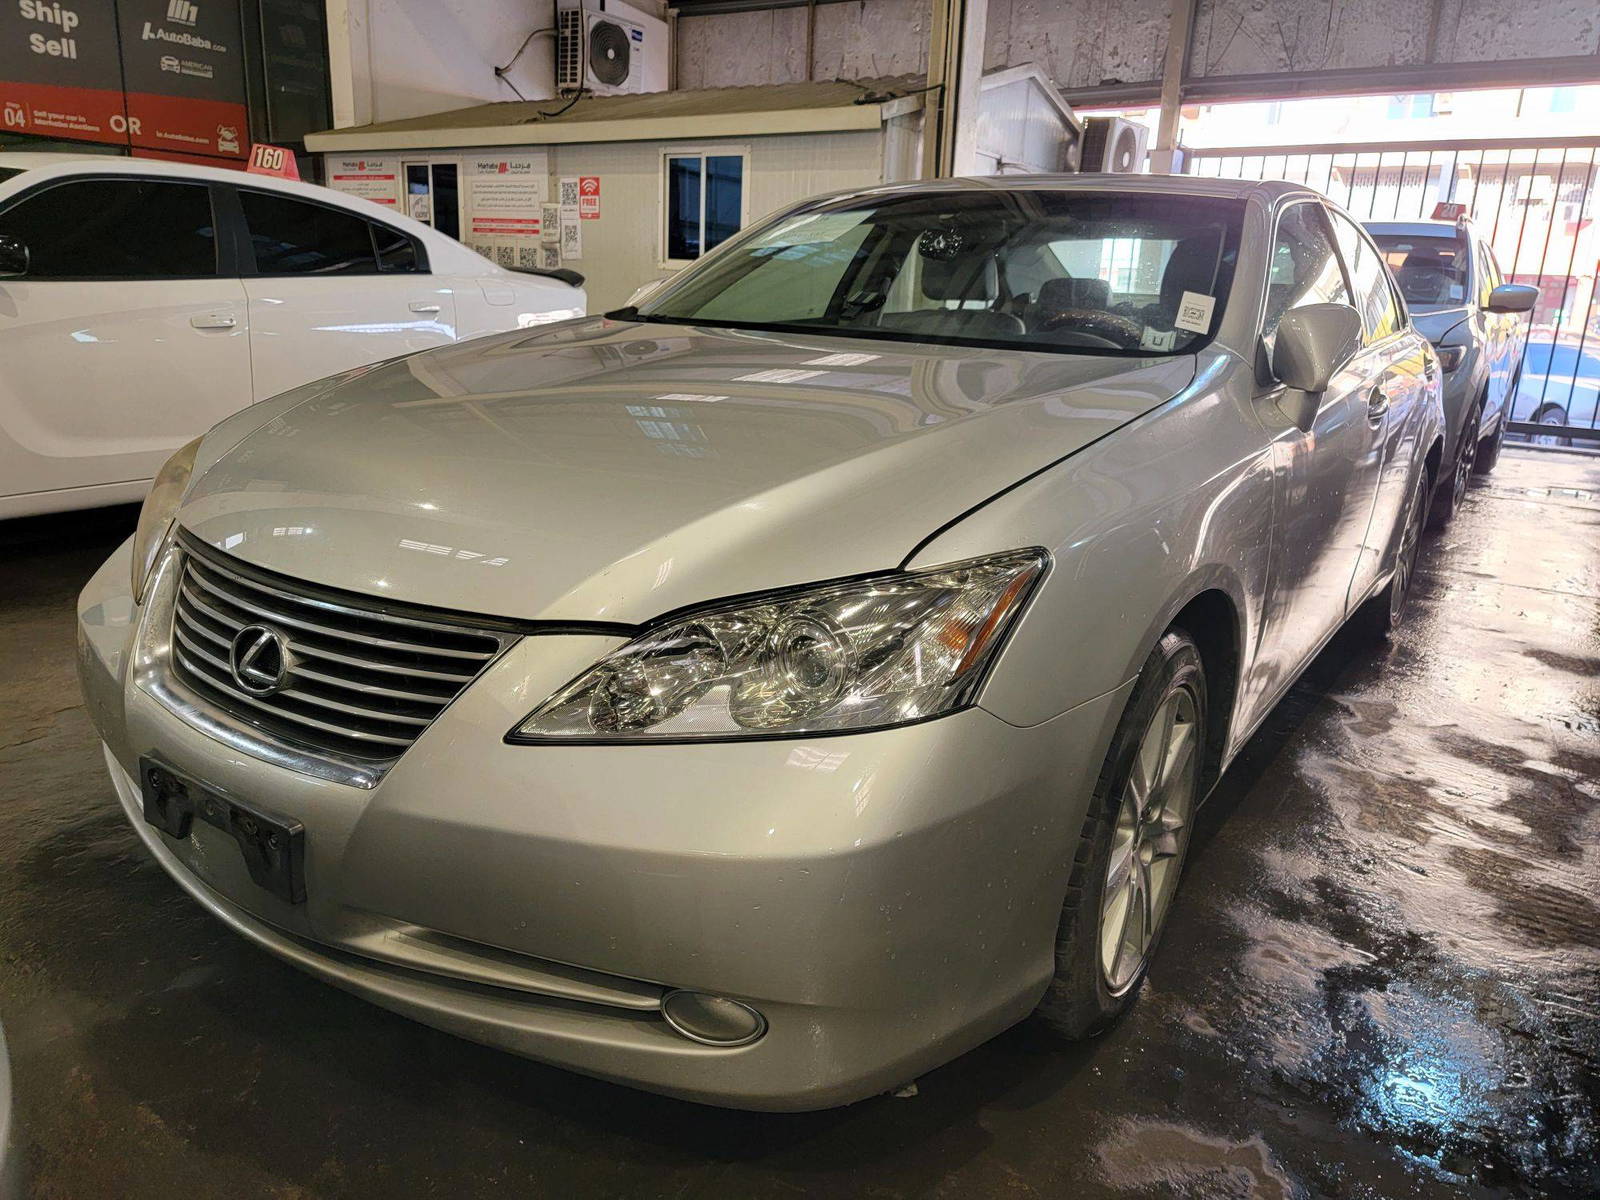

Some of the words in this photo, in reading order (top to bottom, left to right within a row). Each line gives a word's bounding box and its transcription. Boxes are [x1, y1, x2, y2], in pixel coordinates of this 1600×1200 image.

[19, 0, 79, 33] Ship
[29, 33, 77, 59] Sell
[4, 108, 26, 127] 04
[109, 114, 142, 136] OR
[255, 146, 284, 171] 160
